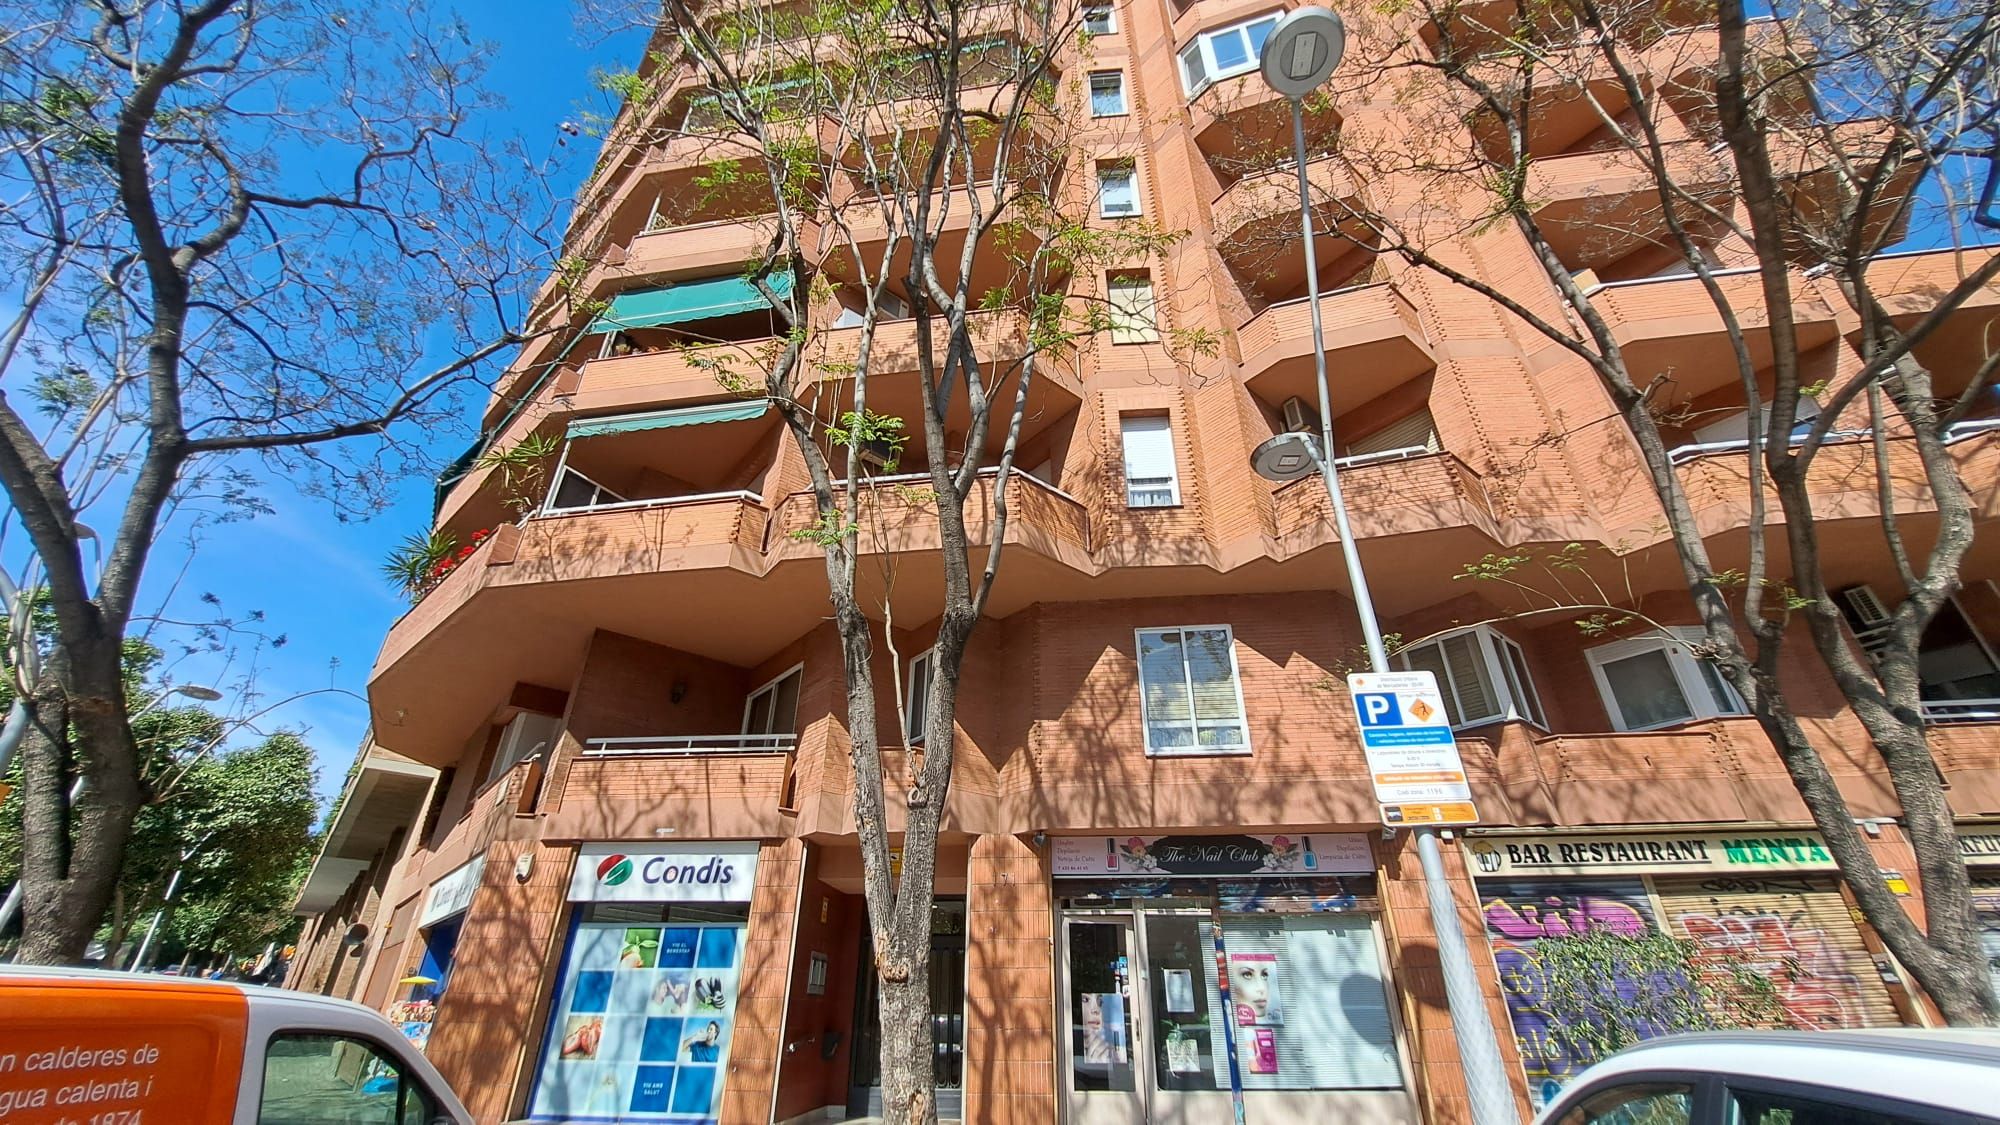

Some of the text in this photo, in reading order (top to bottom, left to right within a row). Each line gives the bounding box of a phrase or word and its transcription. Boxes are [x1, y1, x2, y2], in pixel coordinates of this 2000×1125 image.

[1364, 695, 1389, 724] P
[1160, 844, 1259, 862] The Nail Club
[1506, 839, 1709, 864] BAR RESTAURANT
[1722, 837, 1831, 864] MENTA
[642, 856, 734, 884] Condis
[24, 1046, 127, 1071] calderes
[133, 1044, 159, 1064] de
[55, 1079, 138, 1104] calenta
[144, 1074, 154, 1097] i
